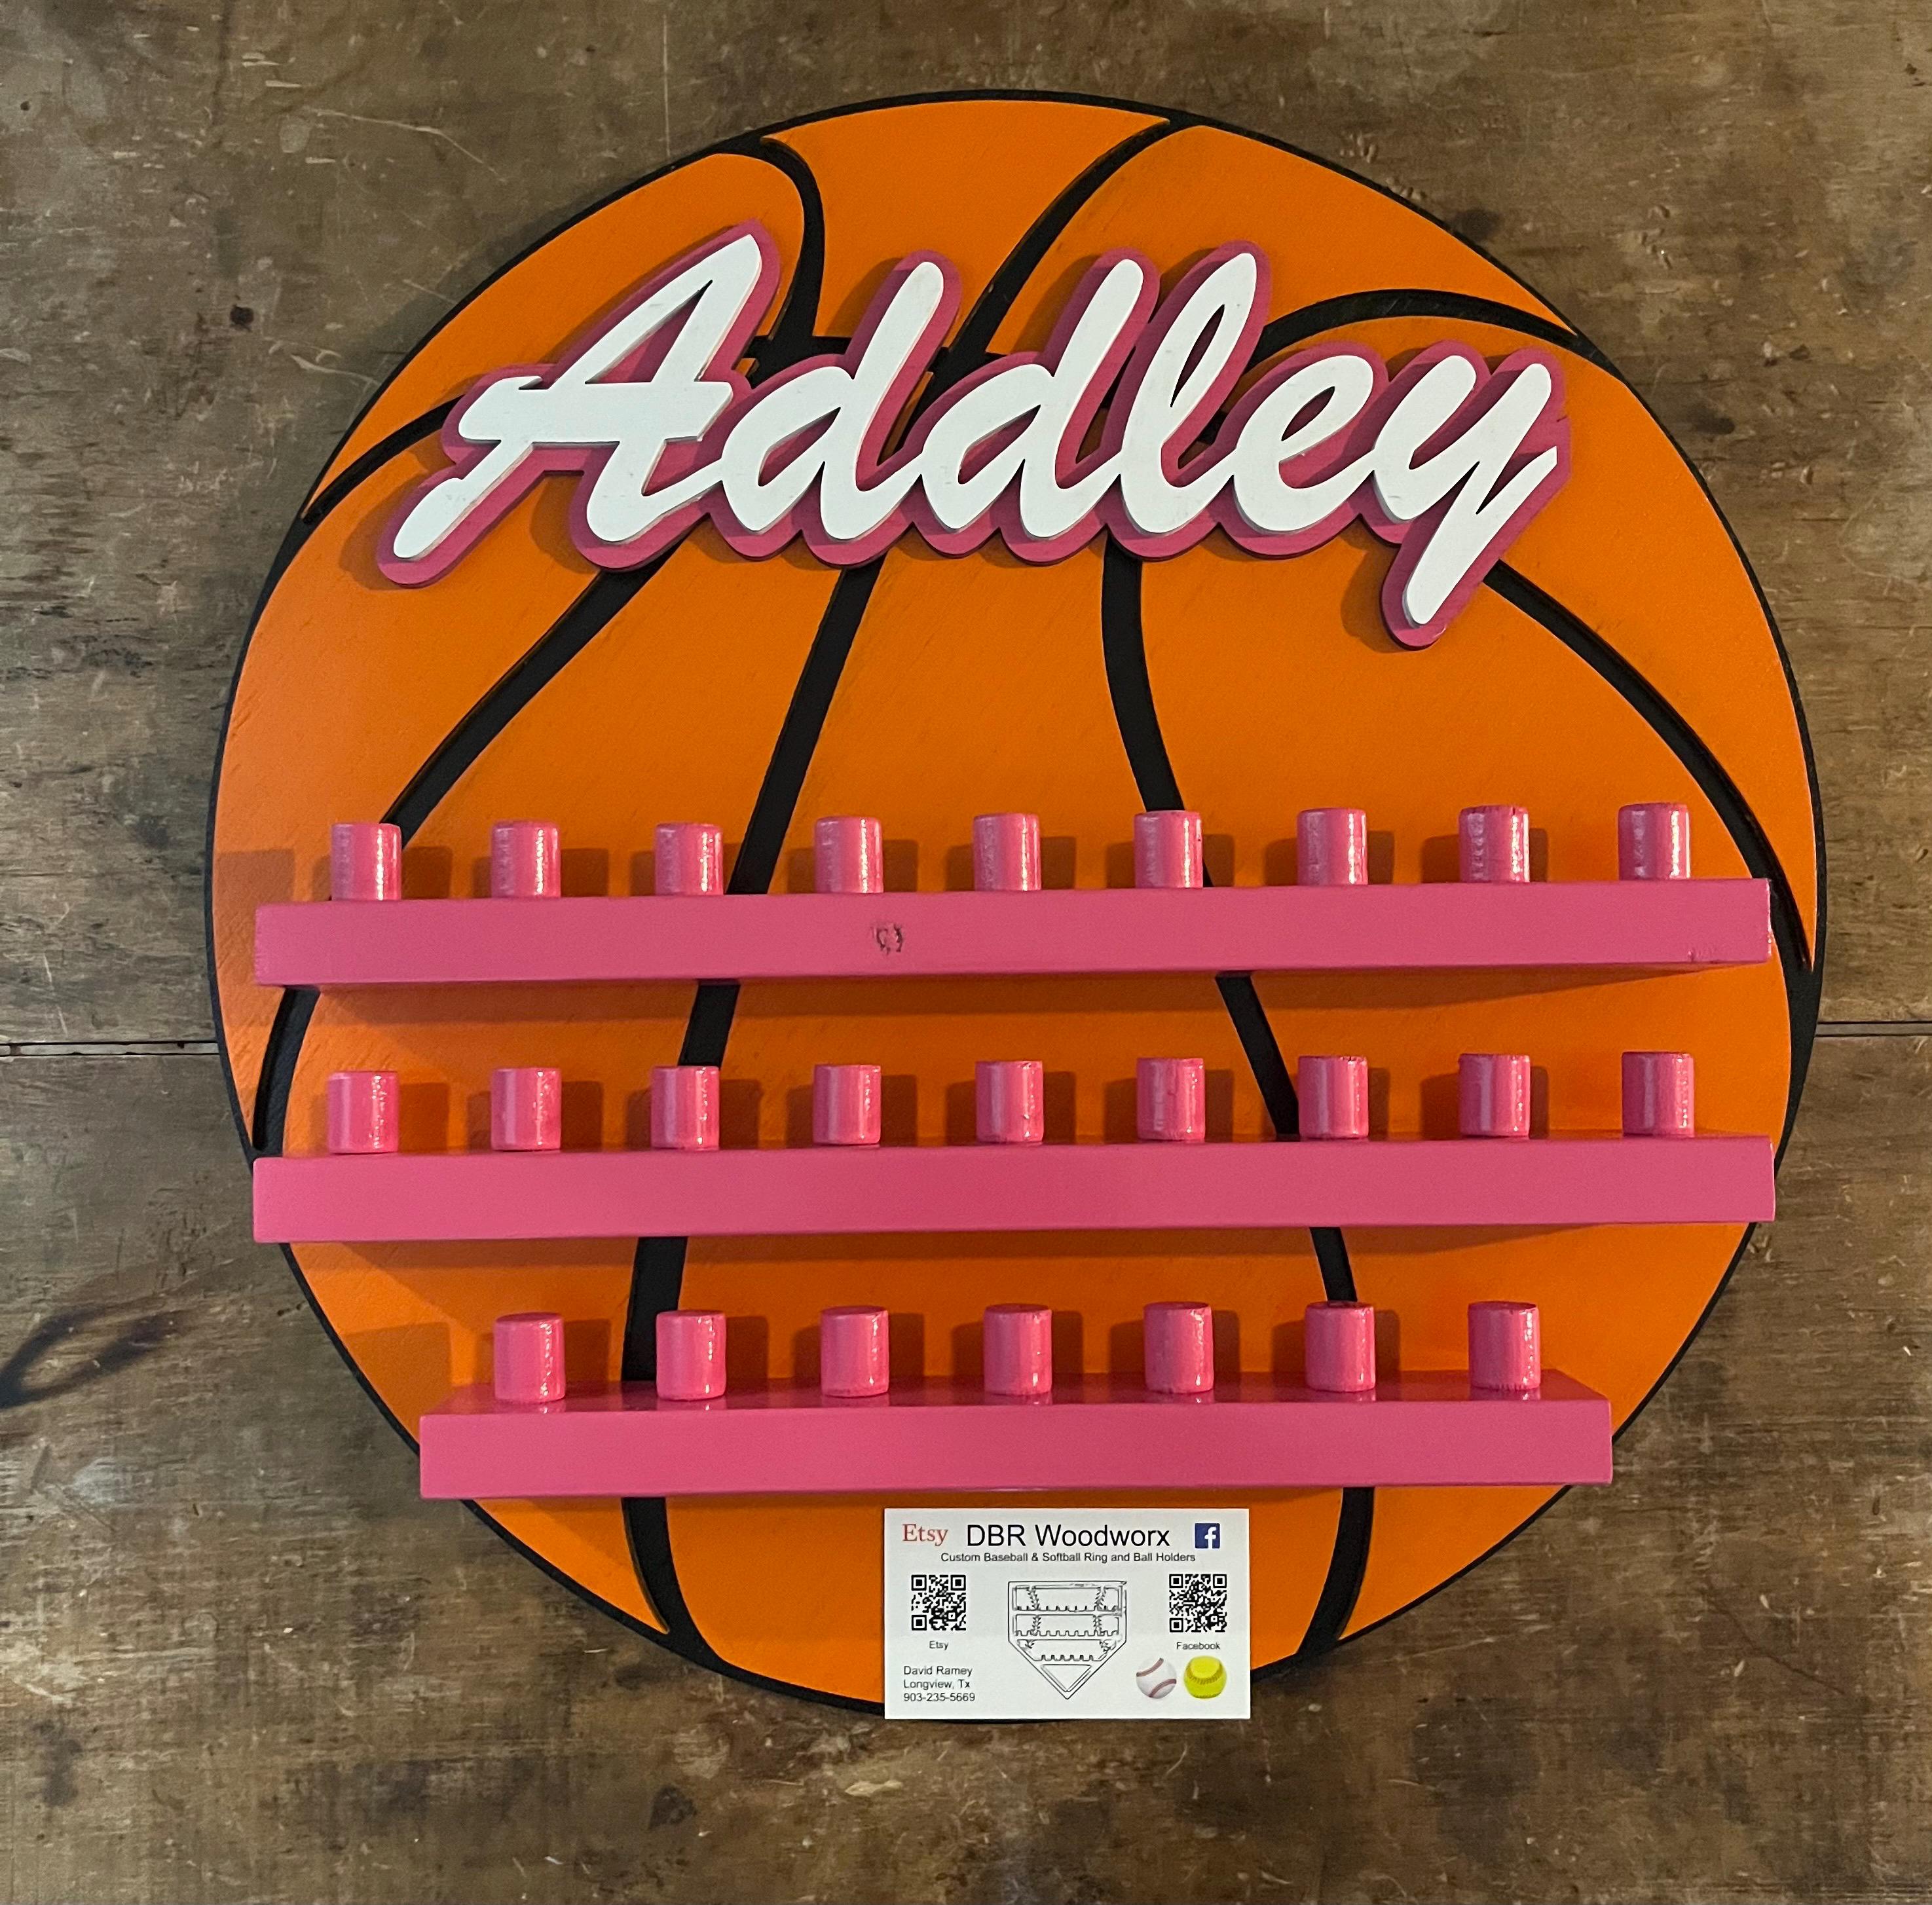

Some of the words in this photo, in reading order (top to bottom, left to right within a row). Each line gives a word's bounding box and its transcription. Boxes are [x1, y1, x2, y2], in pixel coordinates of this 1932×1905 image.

[393, 233, 1559, 625] Addley
[902, 1523, 949, 1547] Etsy
[967, 1524, 1026, 1547] DBR
[1035, 1524, 1170, 1547] Woodworx
[940, 1552, 980, 1563] Custom
[984, 1552, 1028, 1563] Baseball
[1031, 1552, 1039, 1563] &
[1042, 1552, 1081, 1563] Softball
[1084, 1552, 1107, 1564] Ring
[1111, 1552, 1130, 1563] and
[1133, 1552, 1153, 1563] Ball
[1156, 1552, 1196, 1563] Holders
[929, 1640, 949, 1651] Etsy
[1176, 1641, 1221, 1650] Facebook
[903, 1665, 933, 1676] David
[936, 1665, 973, 1678] Ramey
[903, 1678, 955, 1691] Longview,
[957, 1678, 971, 1689] Tx
[903, 1692, 976, 1702] 903-235-5669
